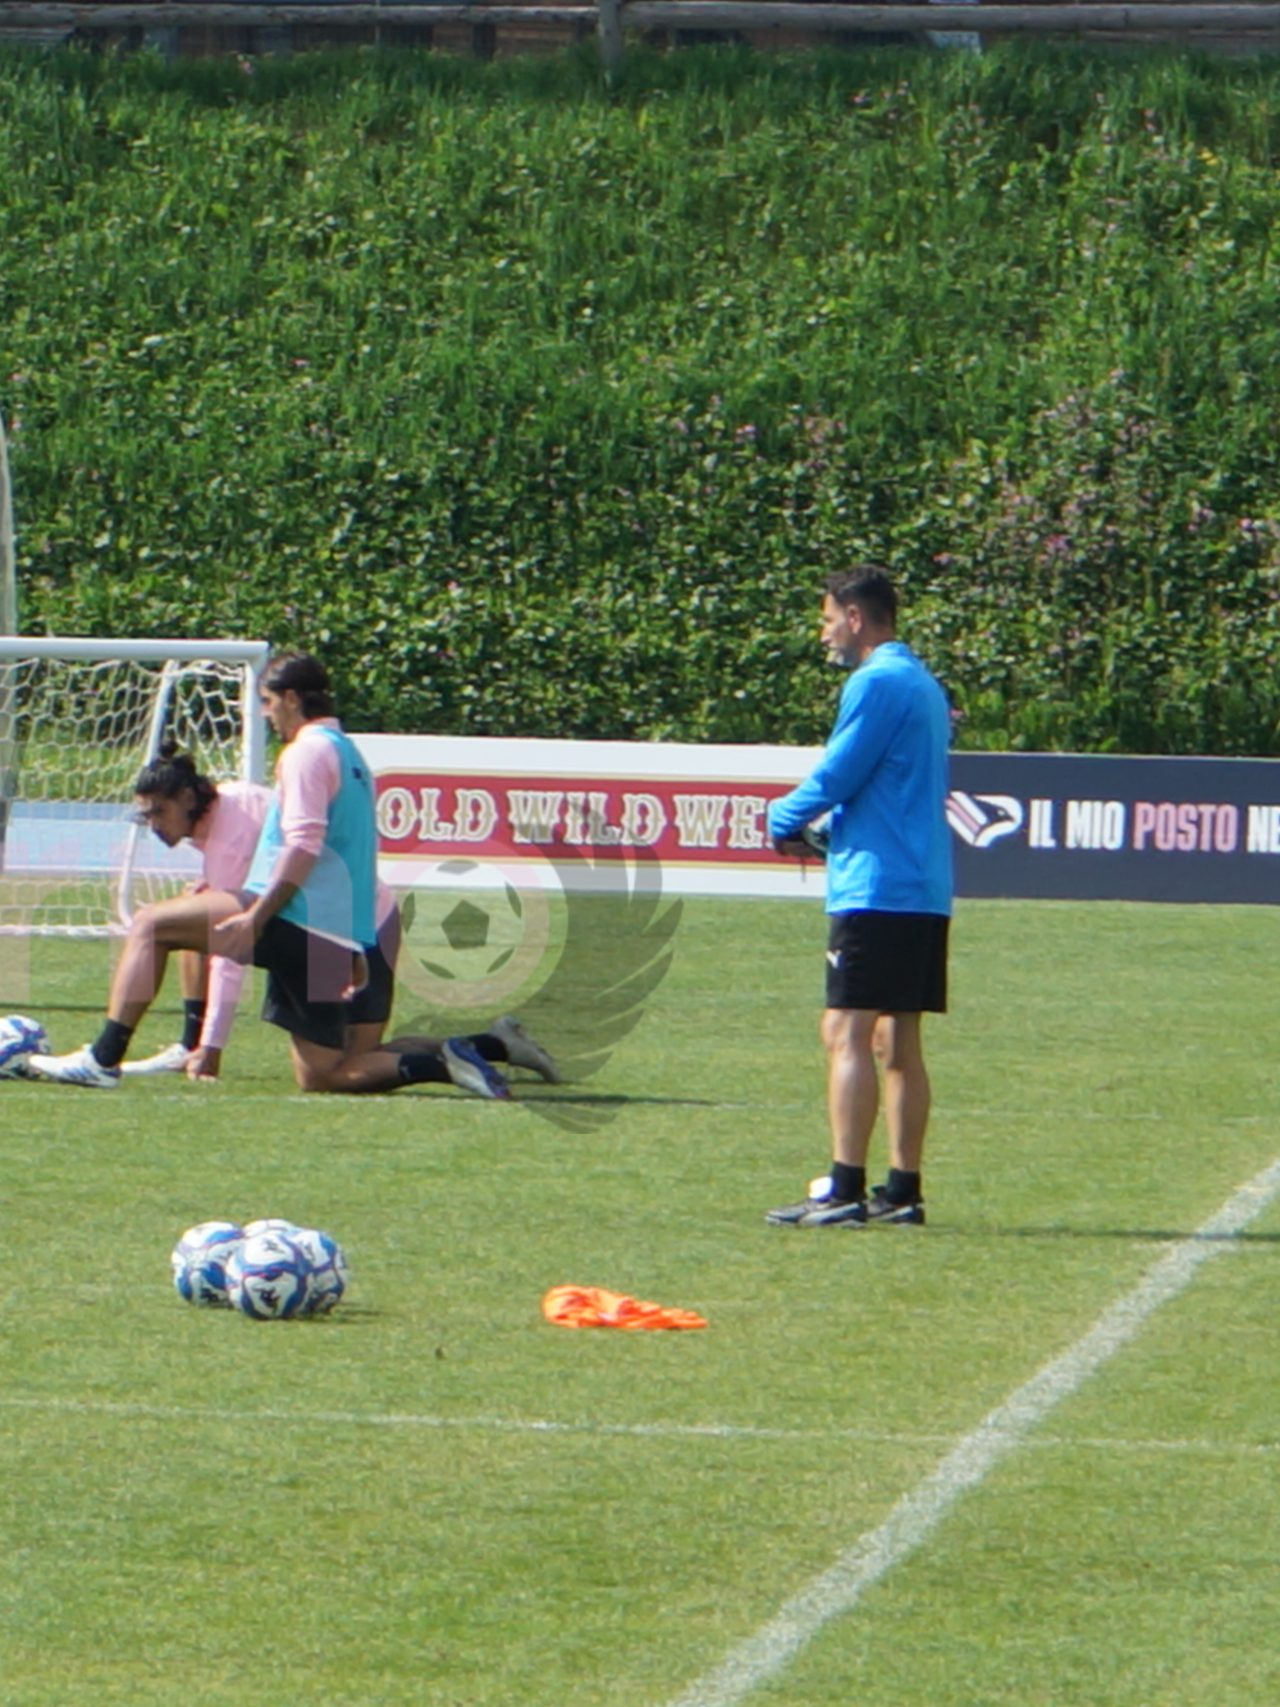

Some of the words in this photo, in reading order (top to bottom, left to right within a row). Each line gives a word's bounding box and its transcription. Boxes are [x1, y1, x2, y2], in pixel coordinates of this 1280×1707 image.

[376, 786, 498, 841] OLD
[506, 790, 667, 847] WILD
[672, 793, 772, 849] WE
[1029, 799, 1056, 847] IL
[1065, 801, 1124, 849] MIO
[1133, 802, 1238, 851] POSTO
